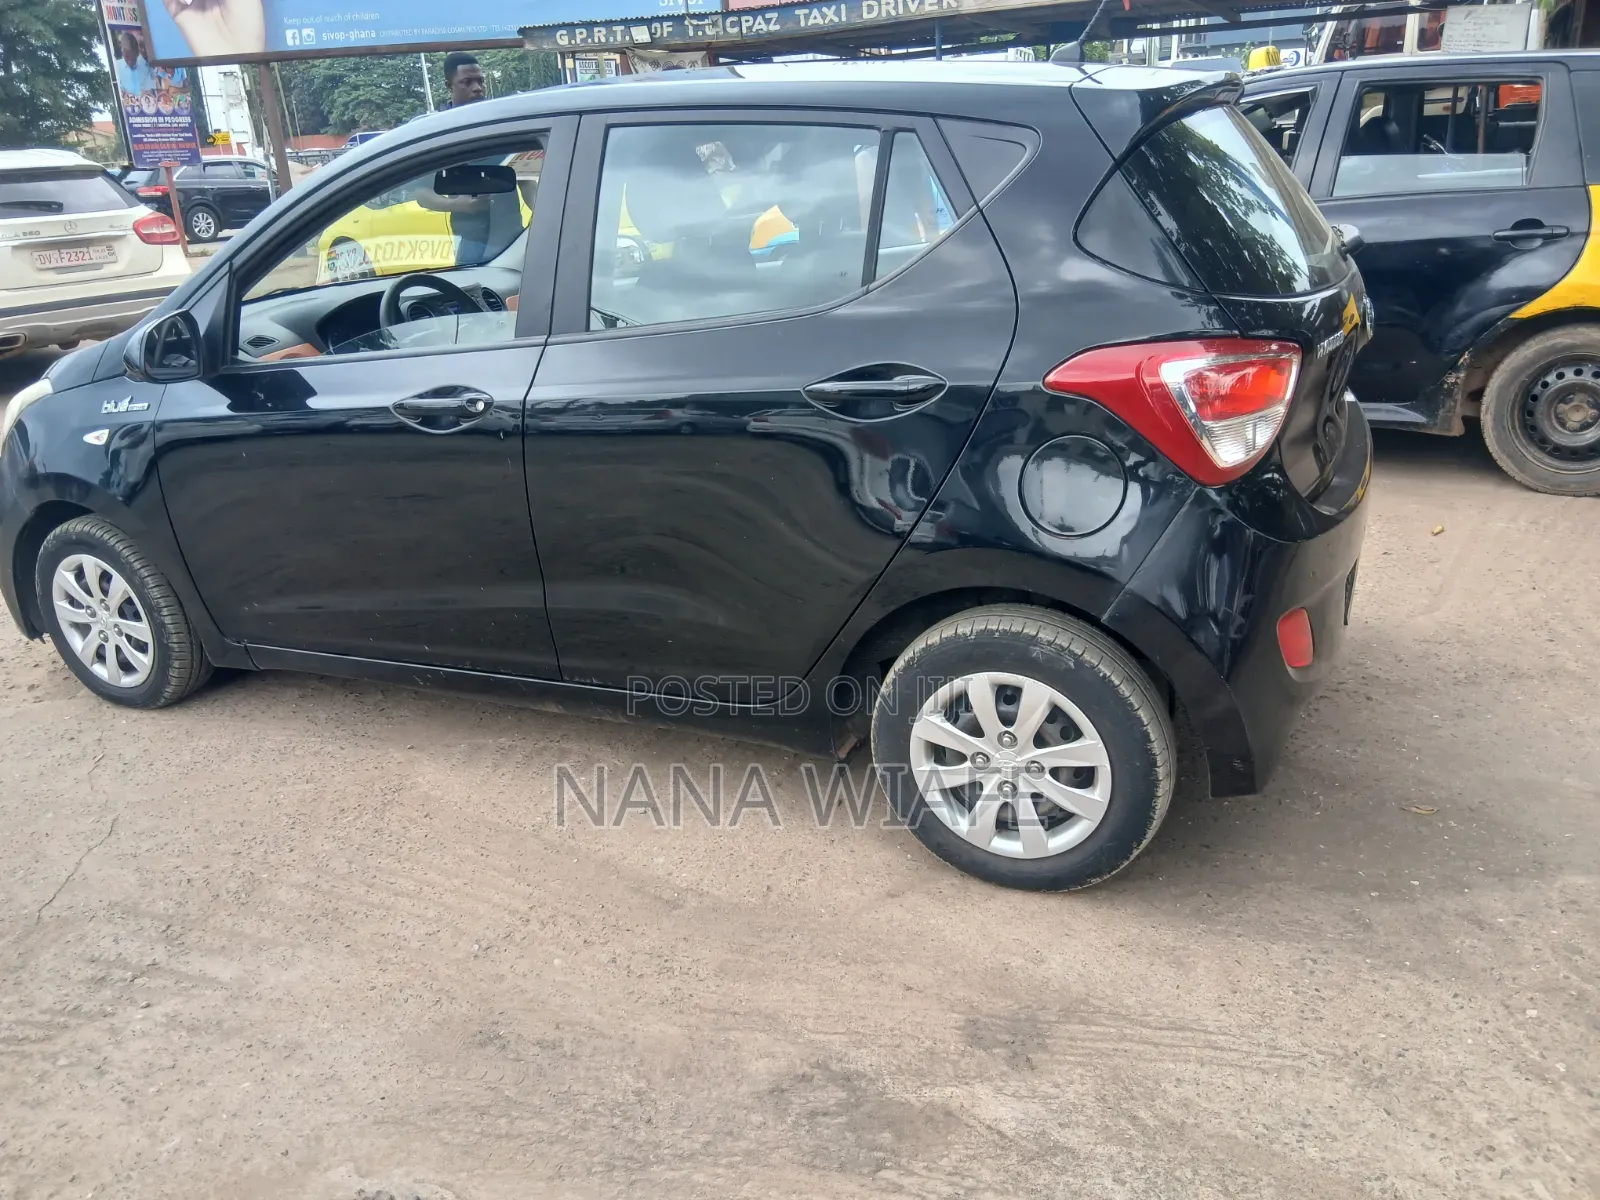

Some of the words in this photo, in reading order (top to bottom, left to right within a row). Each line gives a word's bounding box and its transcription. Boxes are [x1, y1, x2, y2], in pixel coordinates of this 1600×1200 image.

[283, 16, 301, 25] Keep
[303, 16, 315, 24] out
[324, 13, 342, 22] reach
[344, 12, 351, 20] of
[352, 12, 380, 20] children
[555, 25, 630, 46] G.P.R.T.
[651, 22, 673, 38] OF
[794, 3, 847, 28] TAXI
[322, 28, 376, 41] sivop-ghana
